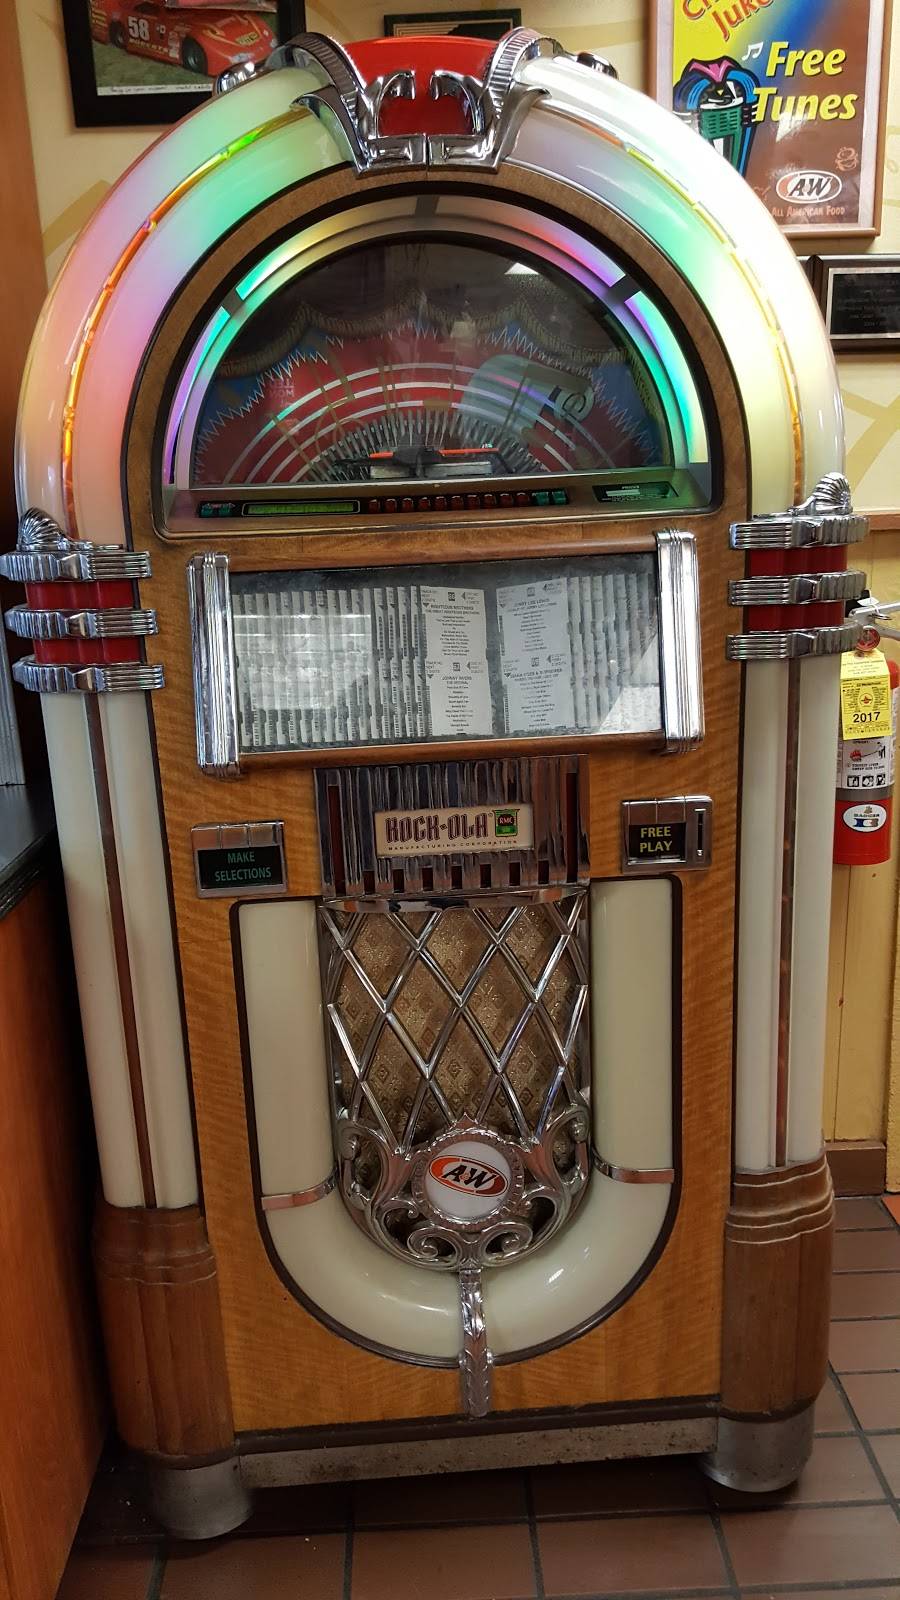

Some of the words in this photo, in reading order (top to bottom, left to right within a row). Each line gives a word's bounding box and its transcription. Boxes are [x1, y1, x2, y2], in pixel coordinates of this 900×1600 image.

[127, 15, 150, 42] 58
[765, 41, 847, 78] Free
[753, 86, 859, 123] Tunes
[853, 711, 881, 723] 2017
[640, 826, 672, 839] FREE
[388, 842, 457, 851] MANUFACTURING
[639, 840, 673, 853] PLAY
[227, 851, 255, 864] MAKE
[214, 866, 272, 882] SELECTIONS
[441, 1164, 498, 1189] A&W
